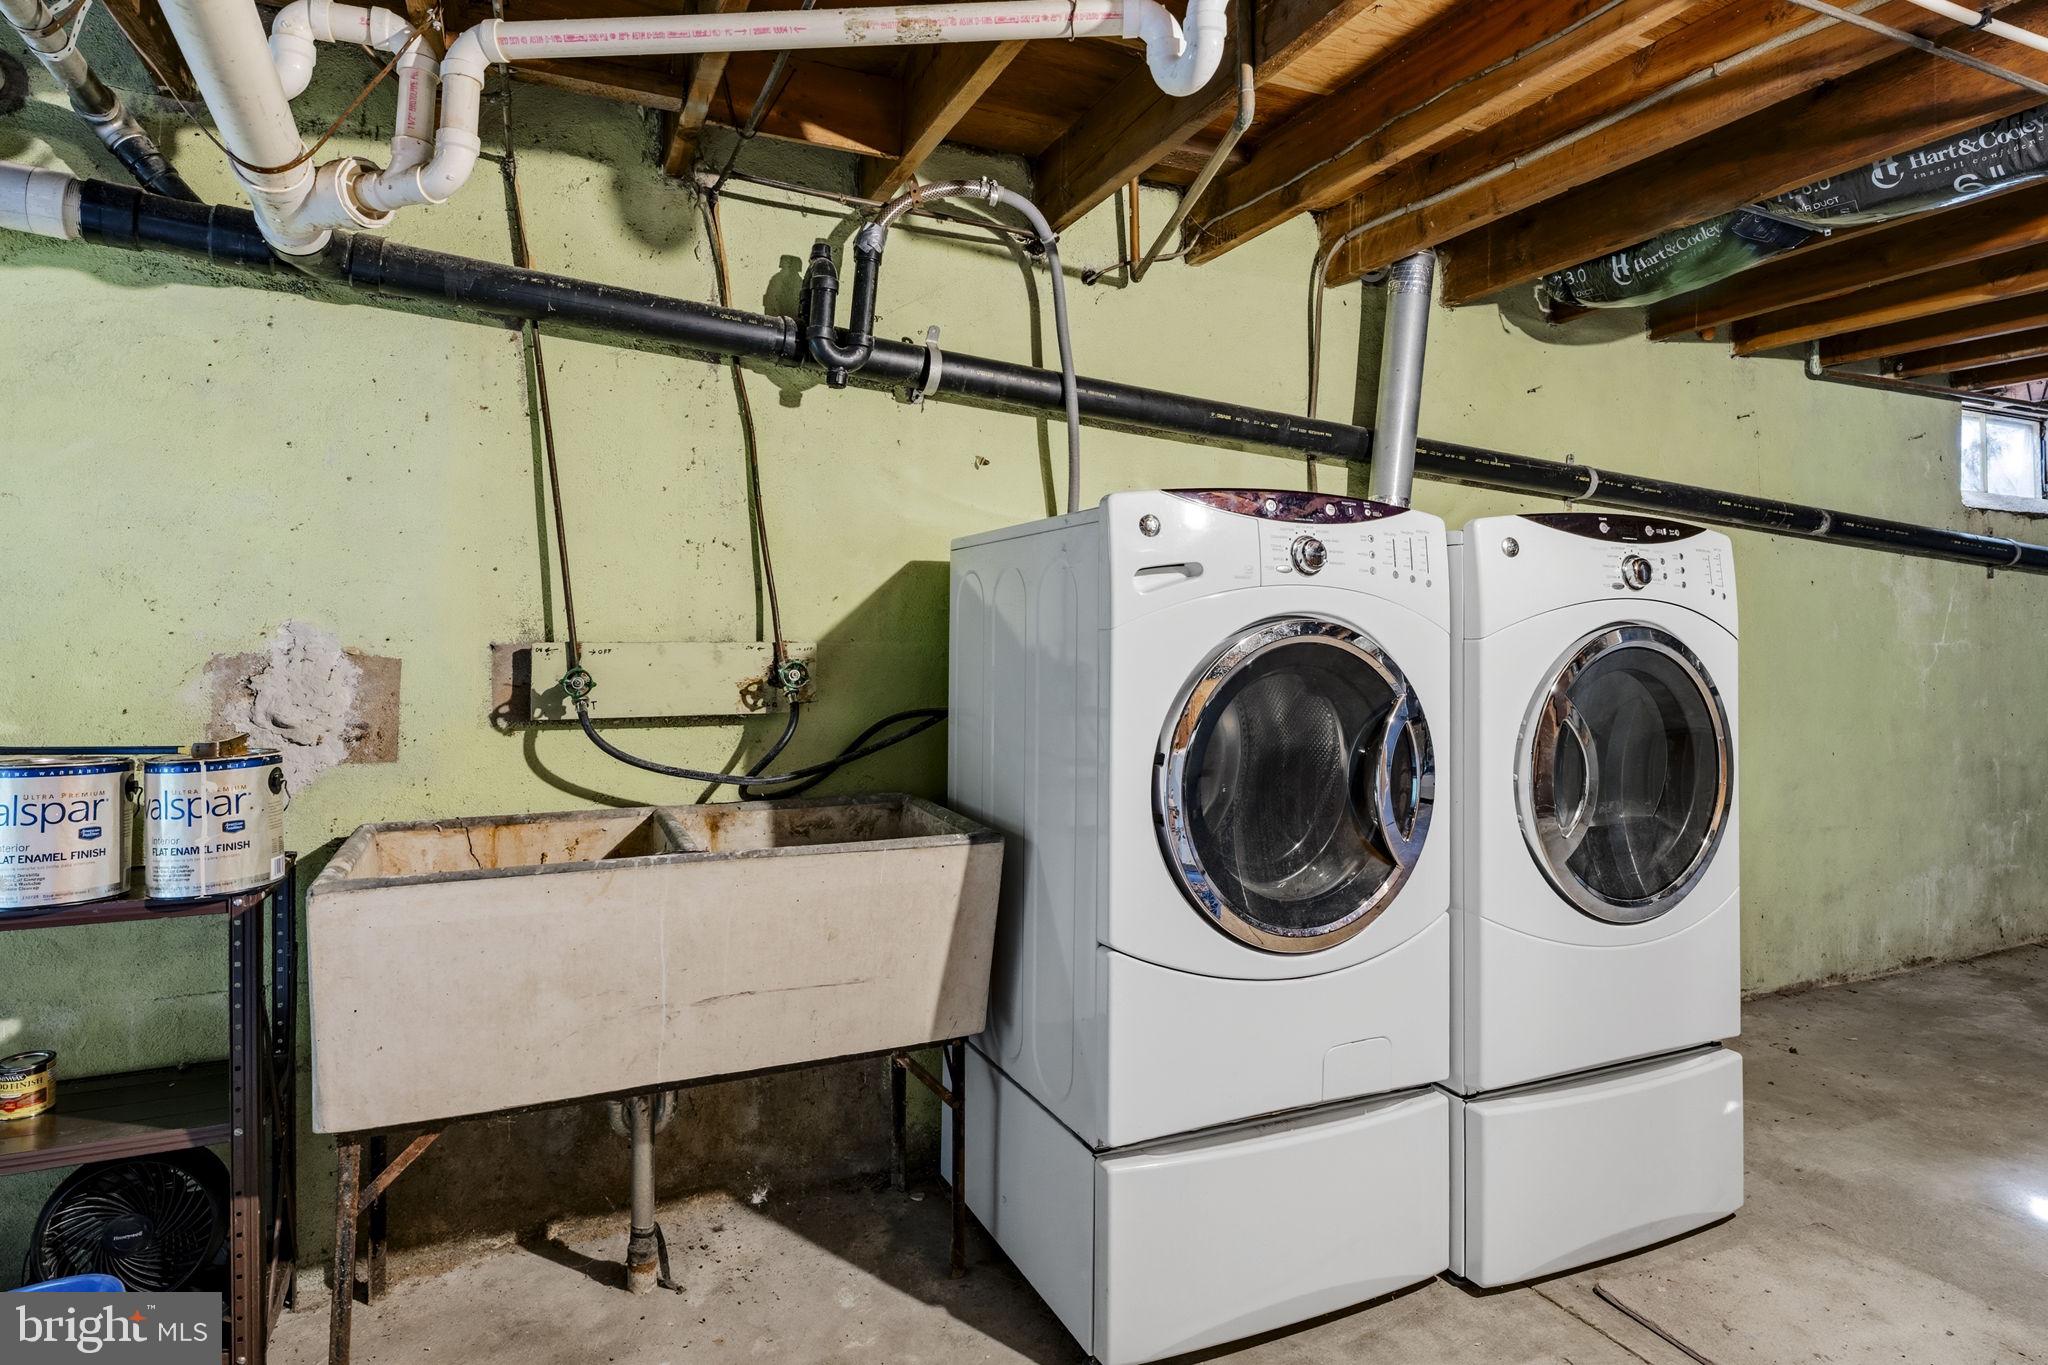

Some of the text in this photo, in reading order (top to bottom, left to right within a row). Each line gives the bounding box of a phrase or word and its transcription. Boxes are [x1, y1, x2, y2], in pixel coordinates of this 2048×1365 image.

[1909, 116, 2045, 170] Hart&Cooley
[1972, 135, 2045, 163] confidenc
[1813, 196, 1840, 210] DUCT
[1633, 224, 1723, 273] Hart&Cooley
[23, 789, 106, 801] ULTRA PREMIUM
[0, 794, 105, 833] alspar
[18, 852, 67, 864] ENAMEL
[71, 847, 107, 860] FINISH
[152, 847, 168, 857] FLAT
[216, 840, 251, 853] FINISH
